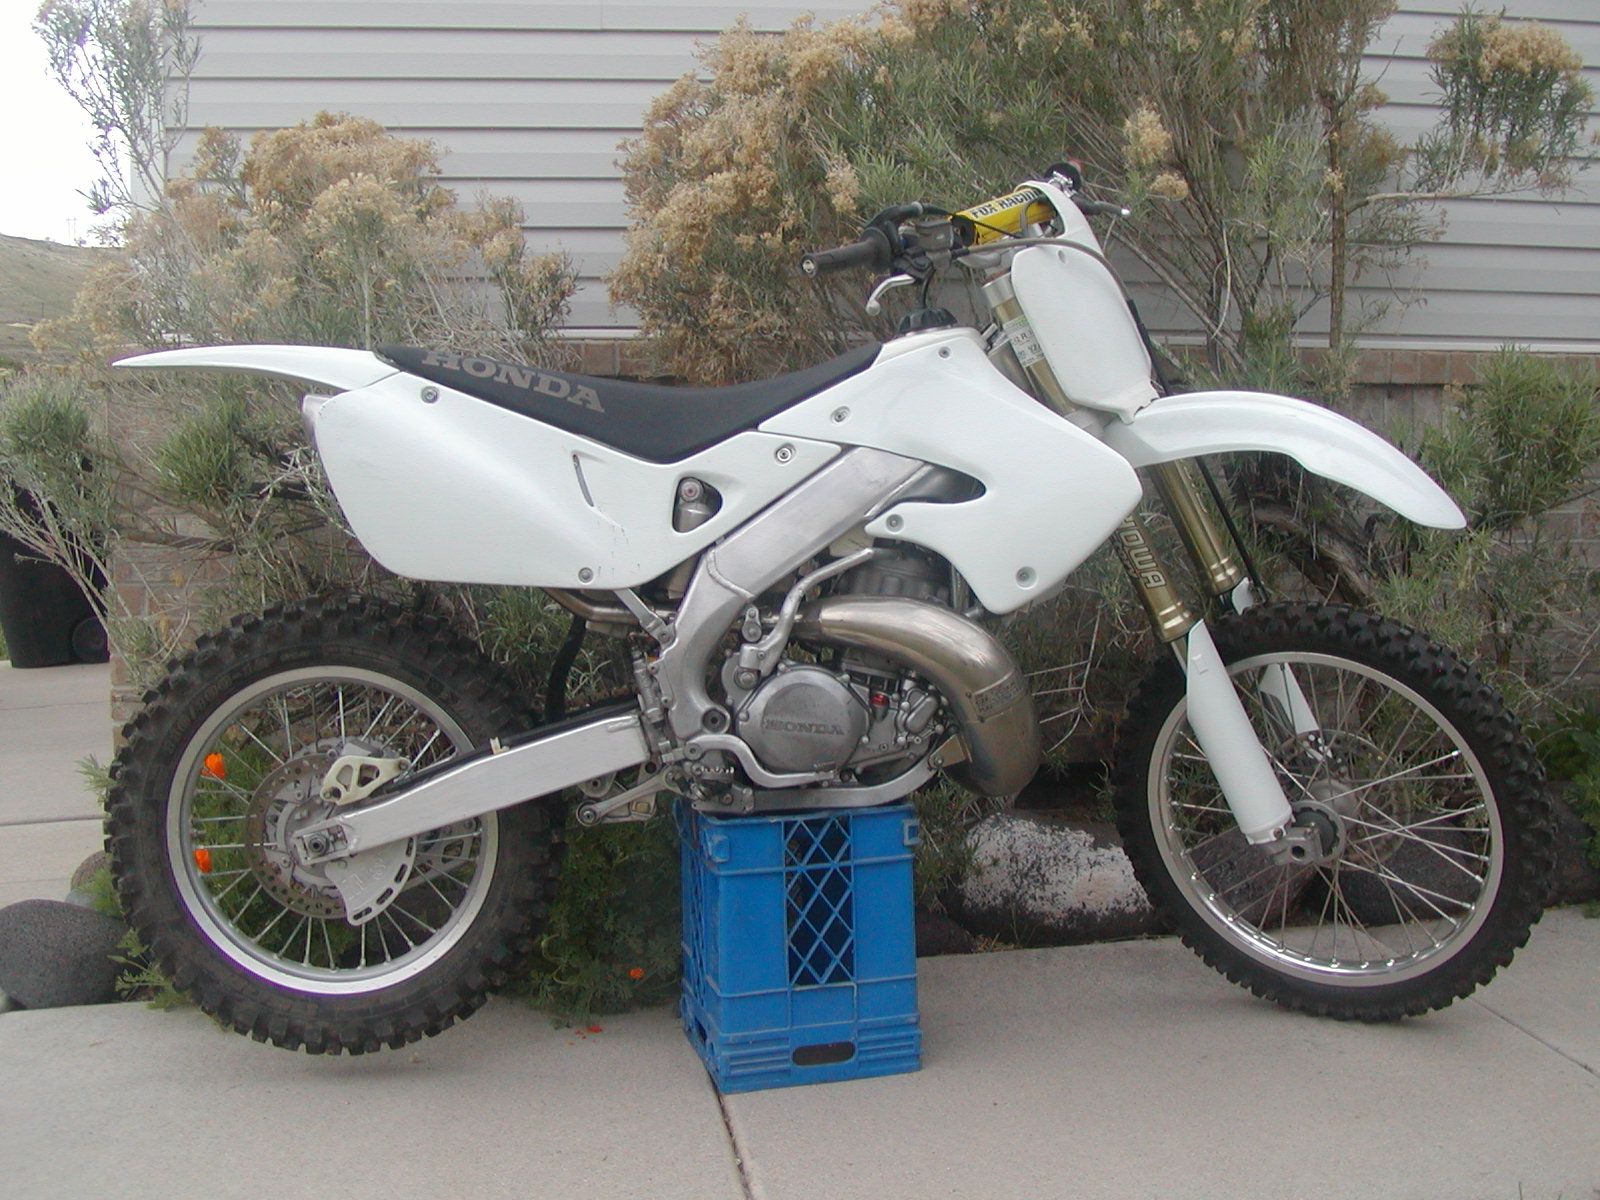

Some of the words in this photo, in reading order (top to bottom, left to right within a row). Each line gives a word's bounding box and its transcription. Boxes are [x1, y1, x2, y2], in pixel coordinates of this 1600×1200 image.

[971, 203, 998, 218] FOX
[421, 349, 605, 413] HONDA
[764, 719, 845, 735] HONDA
